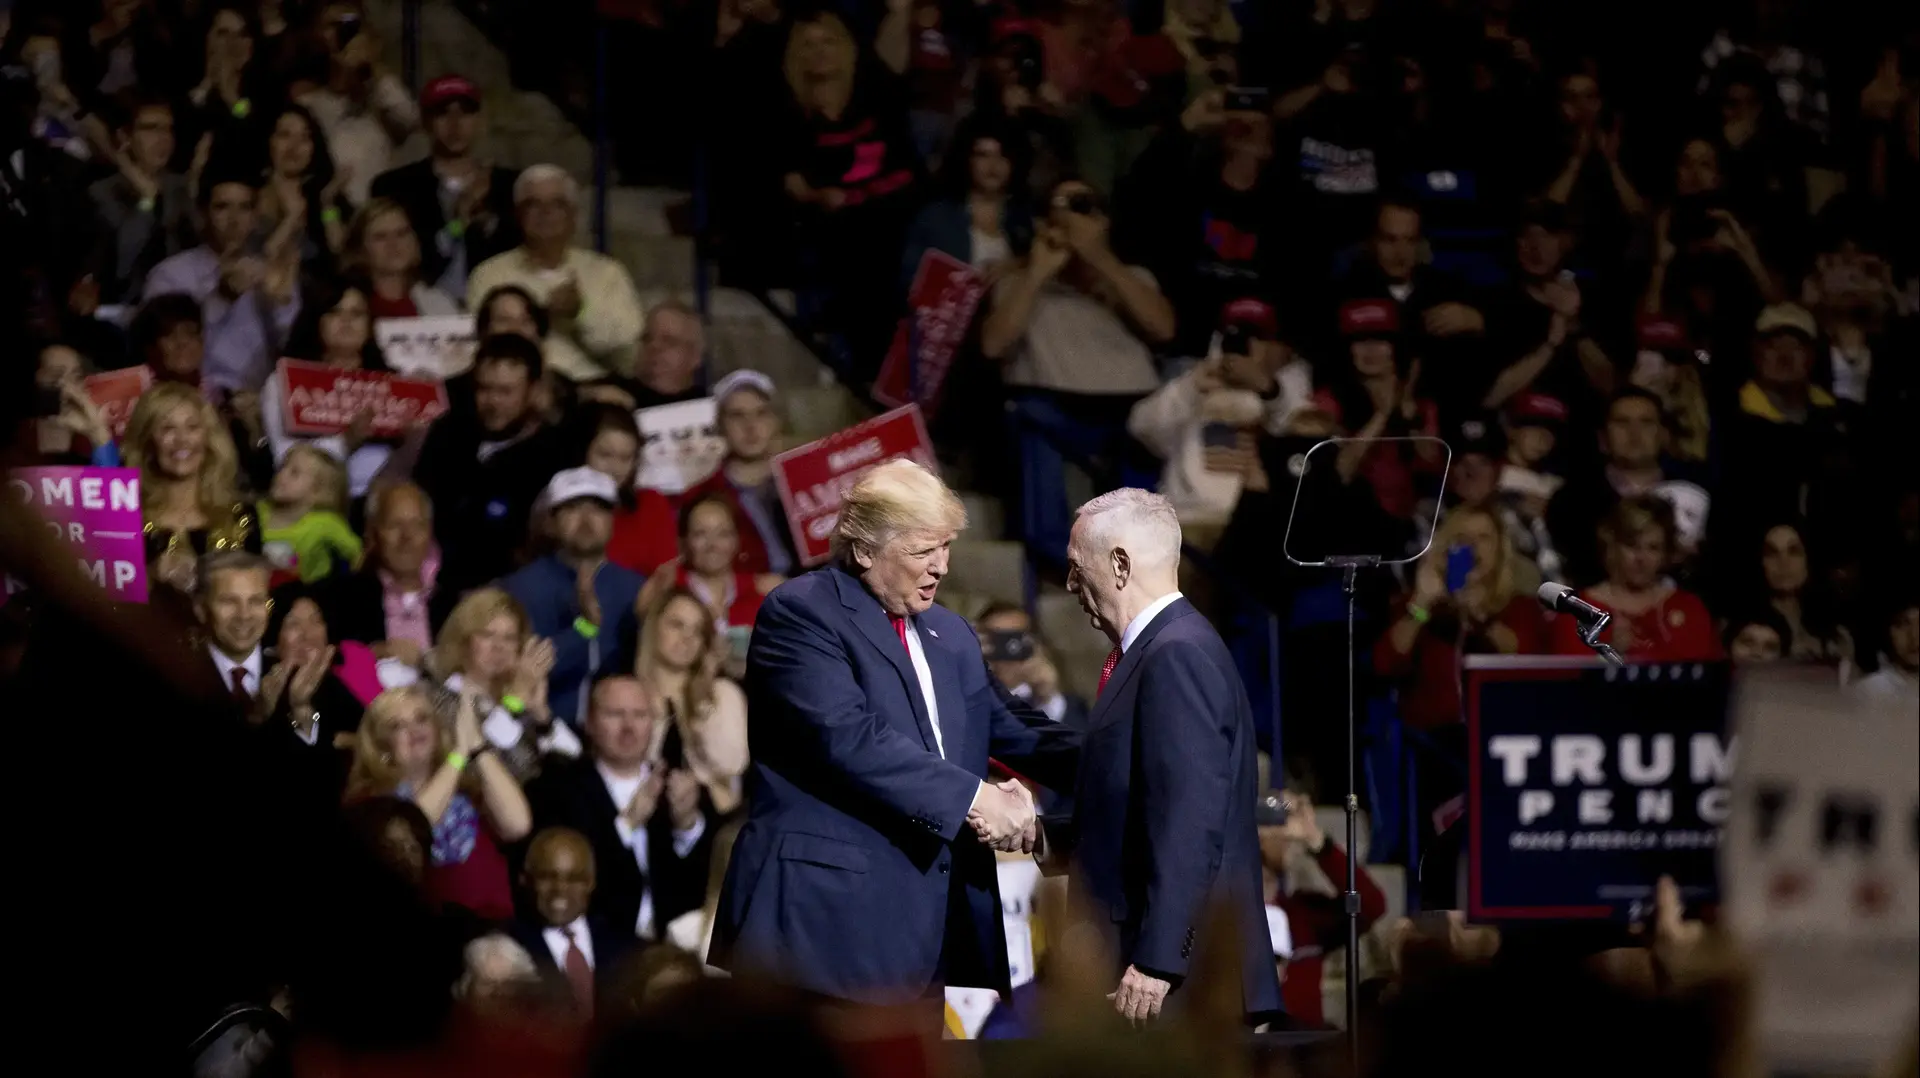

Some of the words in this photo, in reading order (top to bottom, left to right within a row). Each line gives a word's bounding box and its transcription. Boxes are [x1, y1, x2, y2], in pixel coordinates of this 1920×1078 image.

[8, 476, 140, 512] OMEN
[1488, 733, 1740, 787] TRUM
[1518, 787, 1733, 826] PENC
